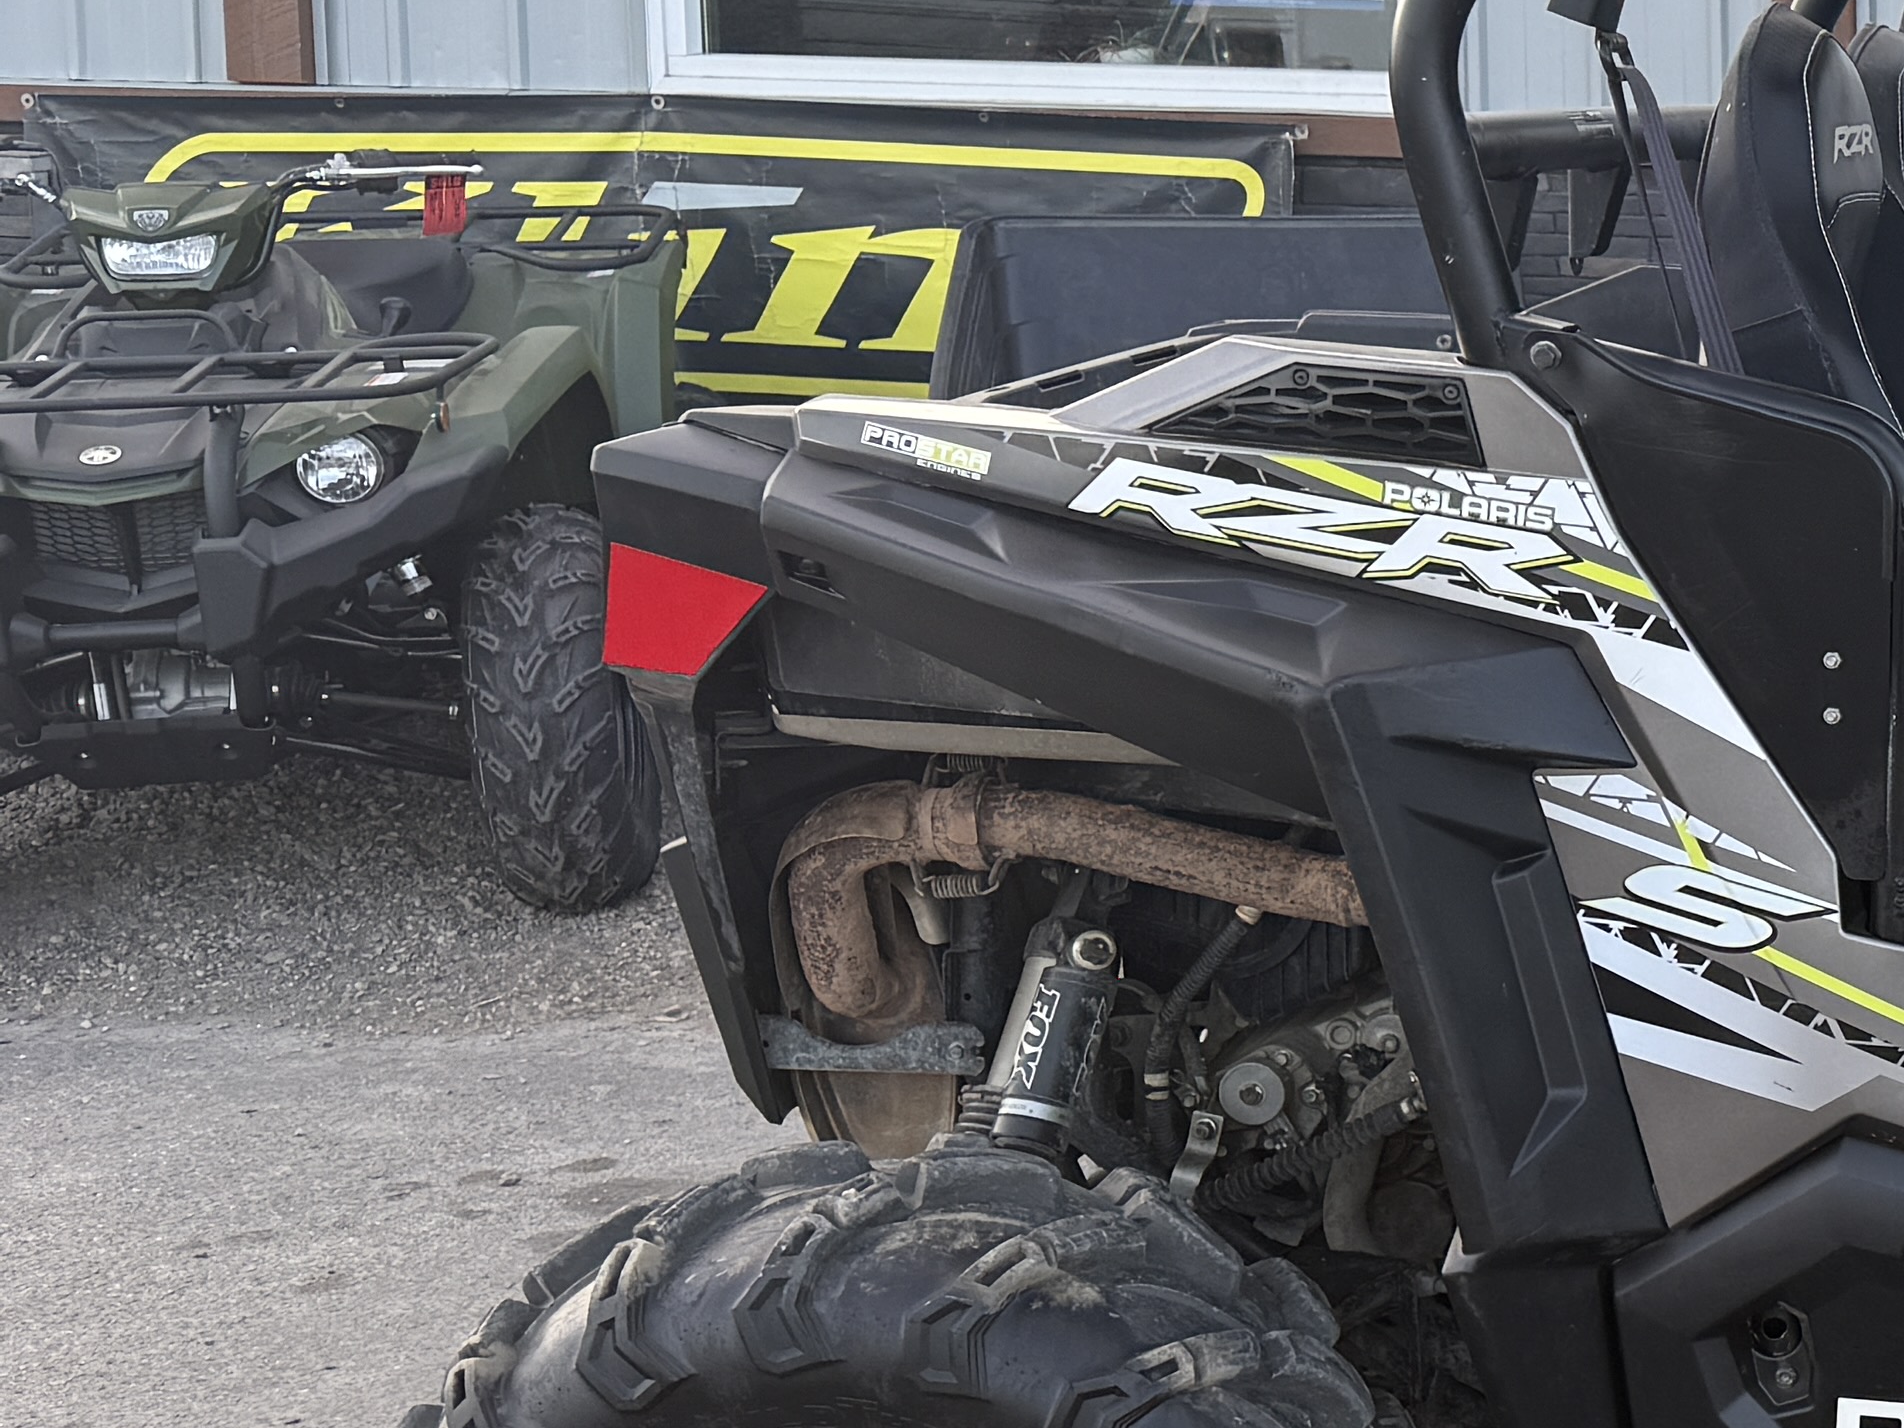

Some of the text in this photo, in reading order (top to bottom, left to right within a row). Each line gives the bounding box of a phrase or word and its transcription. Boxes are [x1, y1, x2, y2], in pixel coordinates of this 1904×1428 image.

[1833, 124, 1874, 164] RZR
[1067, 457, 1583, 604] RZR
[1382, 479, 1554, 529] POLARIS
[1005, 983, 1061, 1090] FOX
